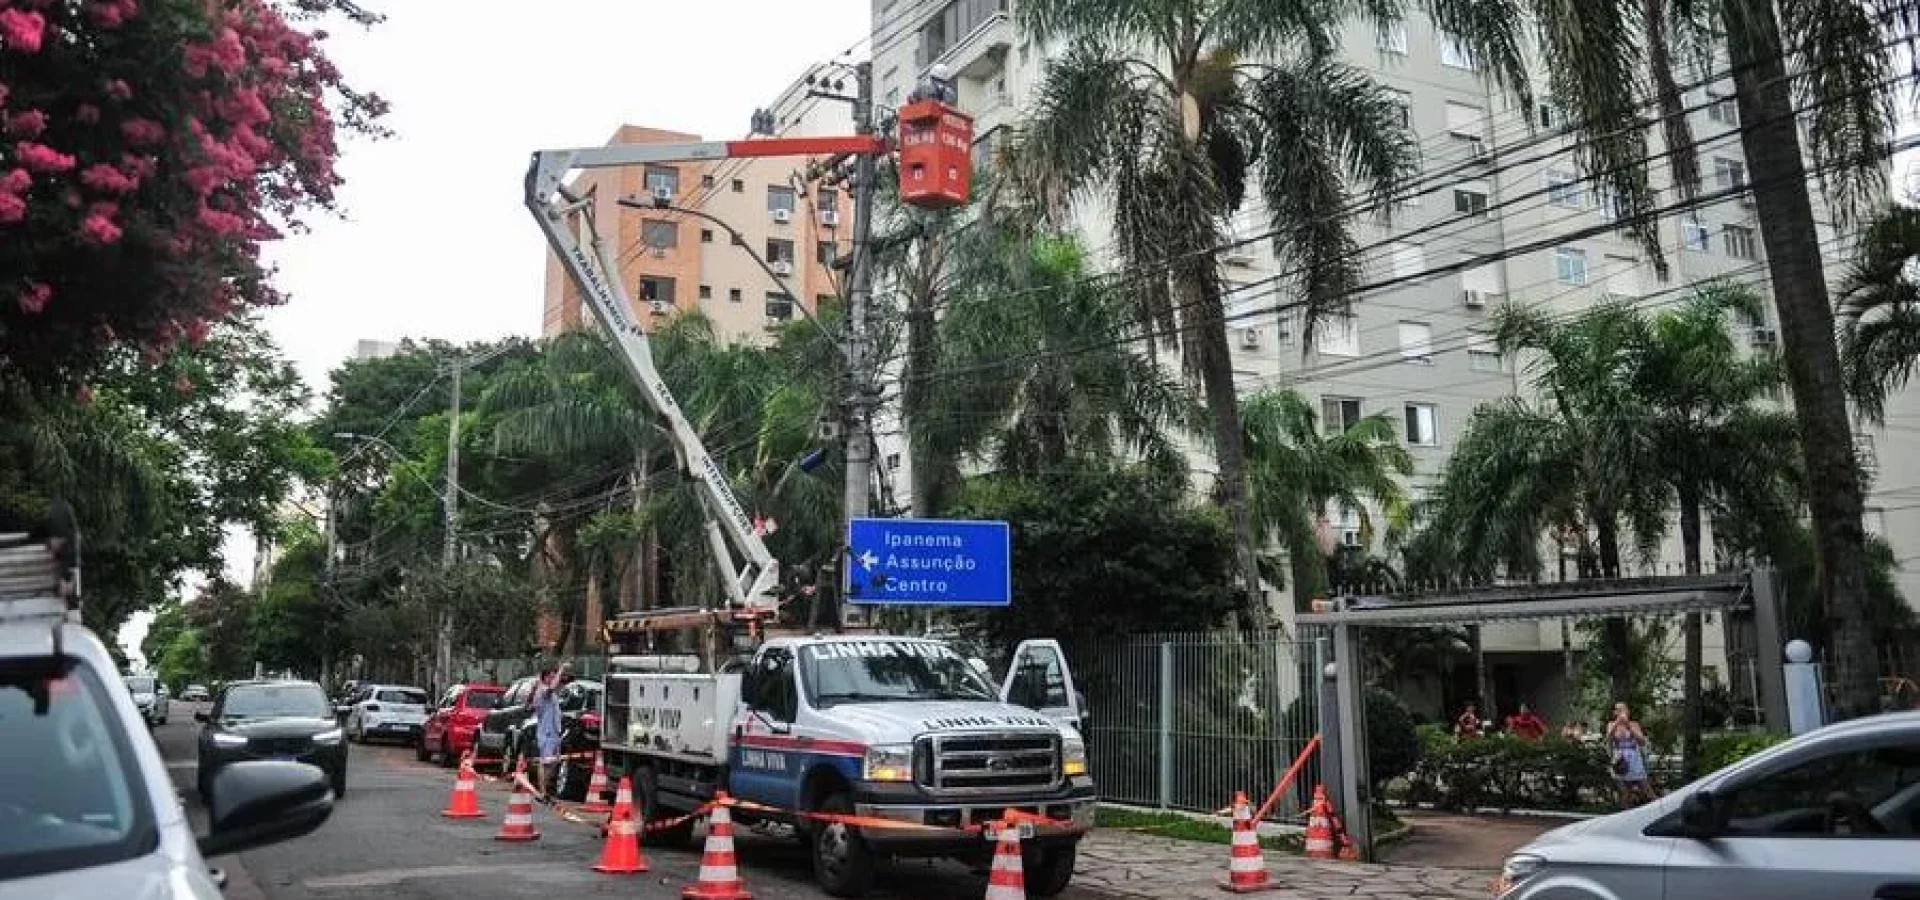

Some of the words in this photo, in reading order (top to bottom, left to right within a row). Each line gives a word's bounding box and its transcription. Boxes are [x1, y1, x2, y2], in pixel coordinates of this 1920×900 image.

[572, 245, 626, 333] TRABALHAMOS
[656, 382, 673, 406] SEM
[884, 530, 962, 548] Ipanema
[886, 553, 976, 571] Assunção
[884, 577, 948, 592] Centro
[810, 642, 899, 660] LINHA
[897, 642, 959, 660] VIVA
[923, 716, 996, 730] LINHA
[998, 715, 1051, 727] VIVA
